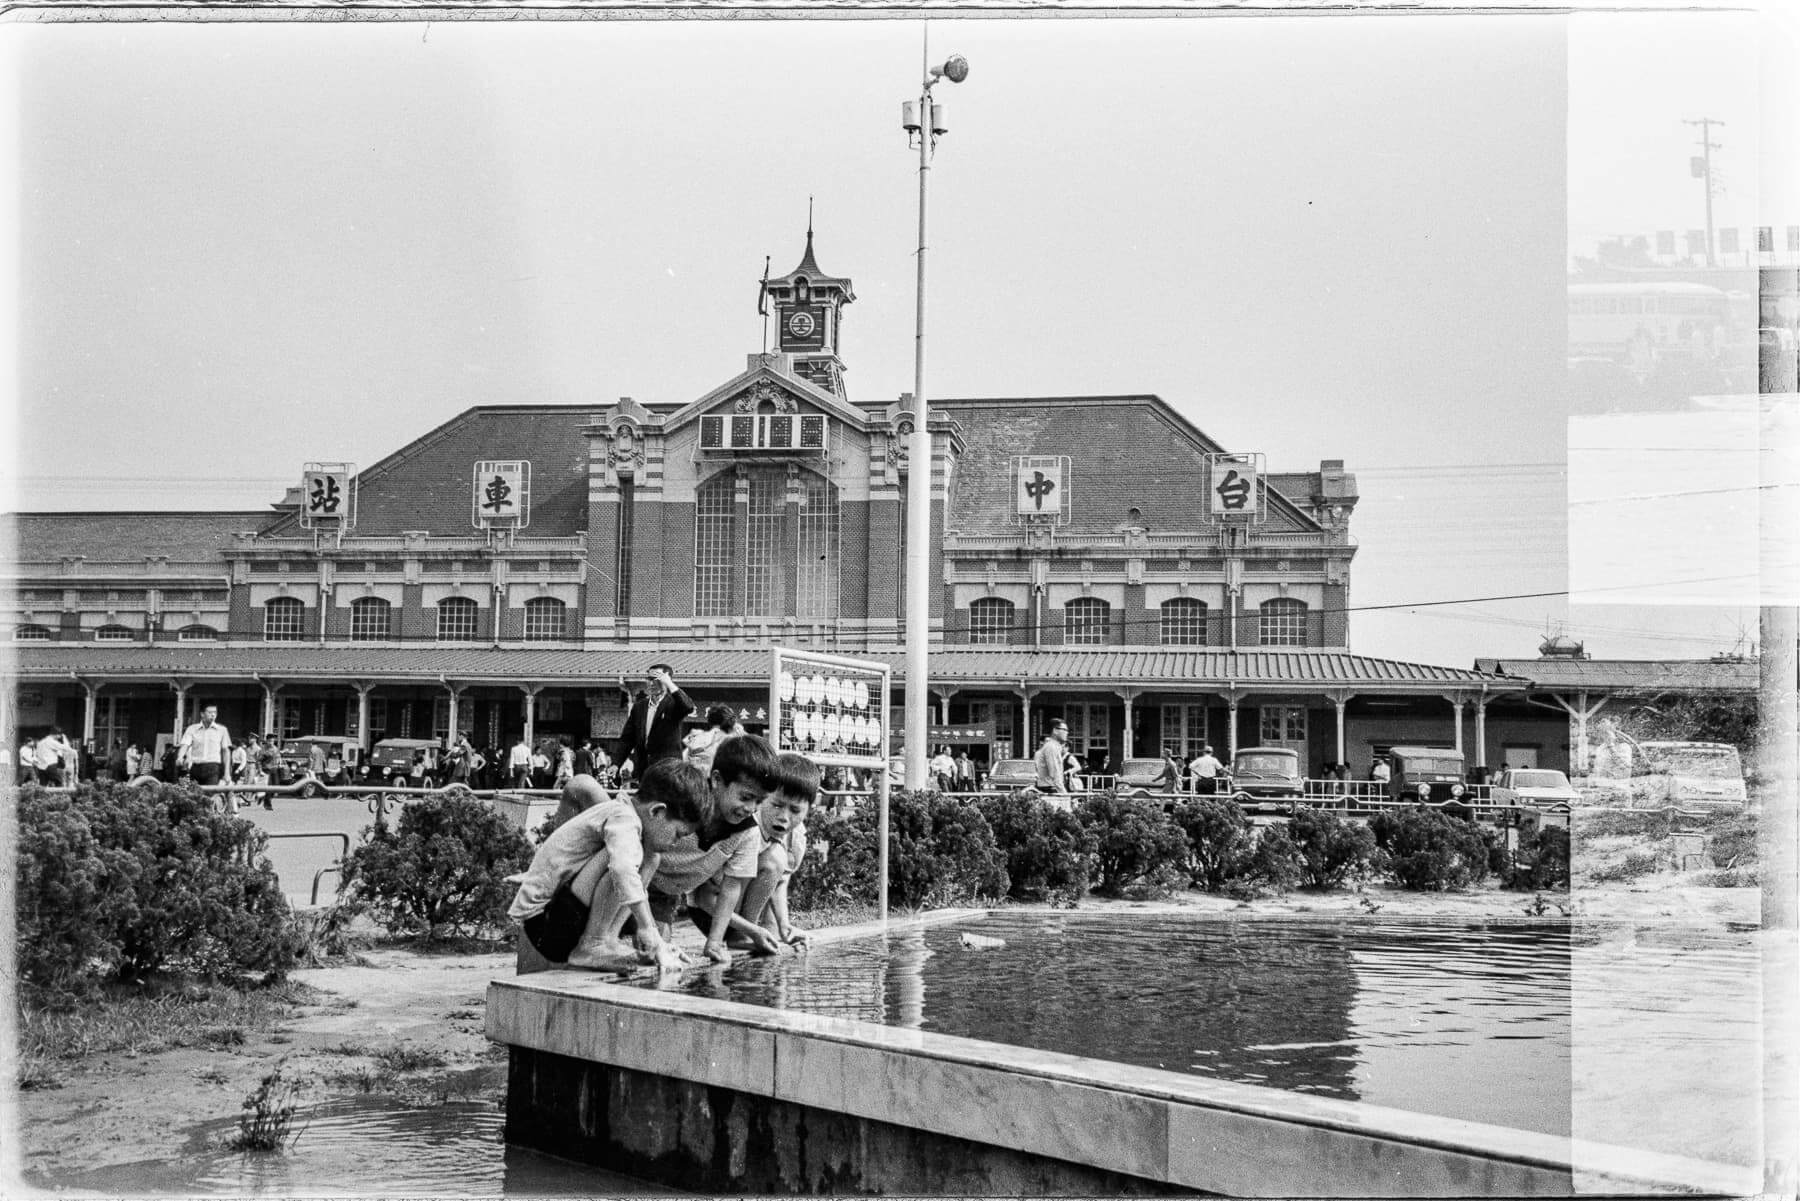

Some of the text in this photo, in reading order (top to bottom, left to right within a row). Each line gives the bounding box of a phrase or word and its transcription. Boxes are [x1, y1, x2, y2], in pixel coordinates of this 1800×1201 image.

[309, 469, 1250, 514] 台 中 車 站
